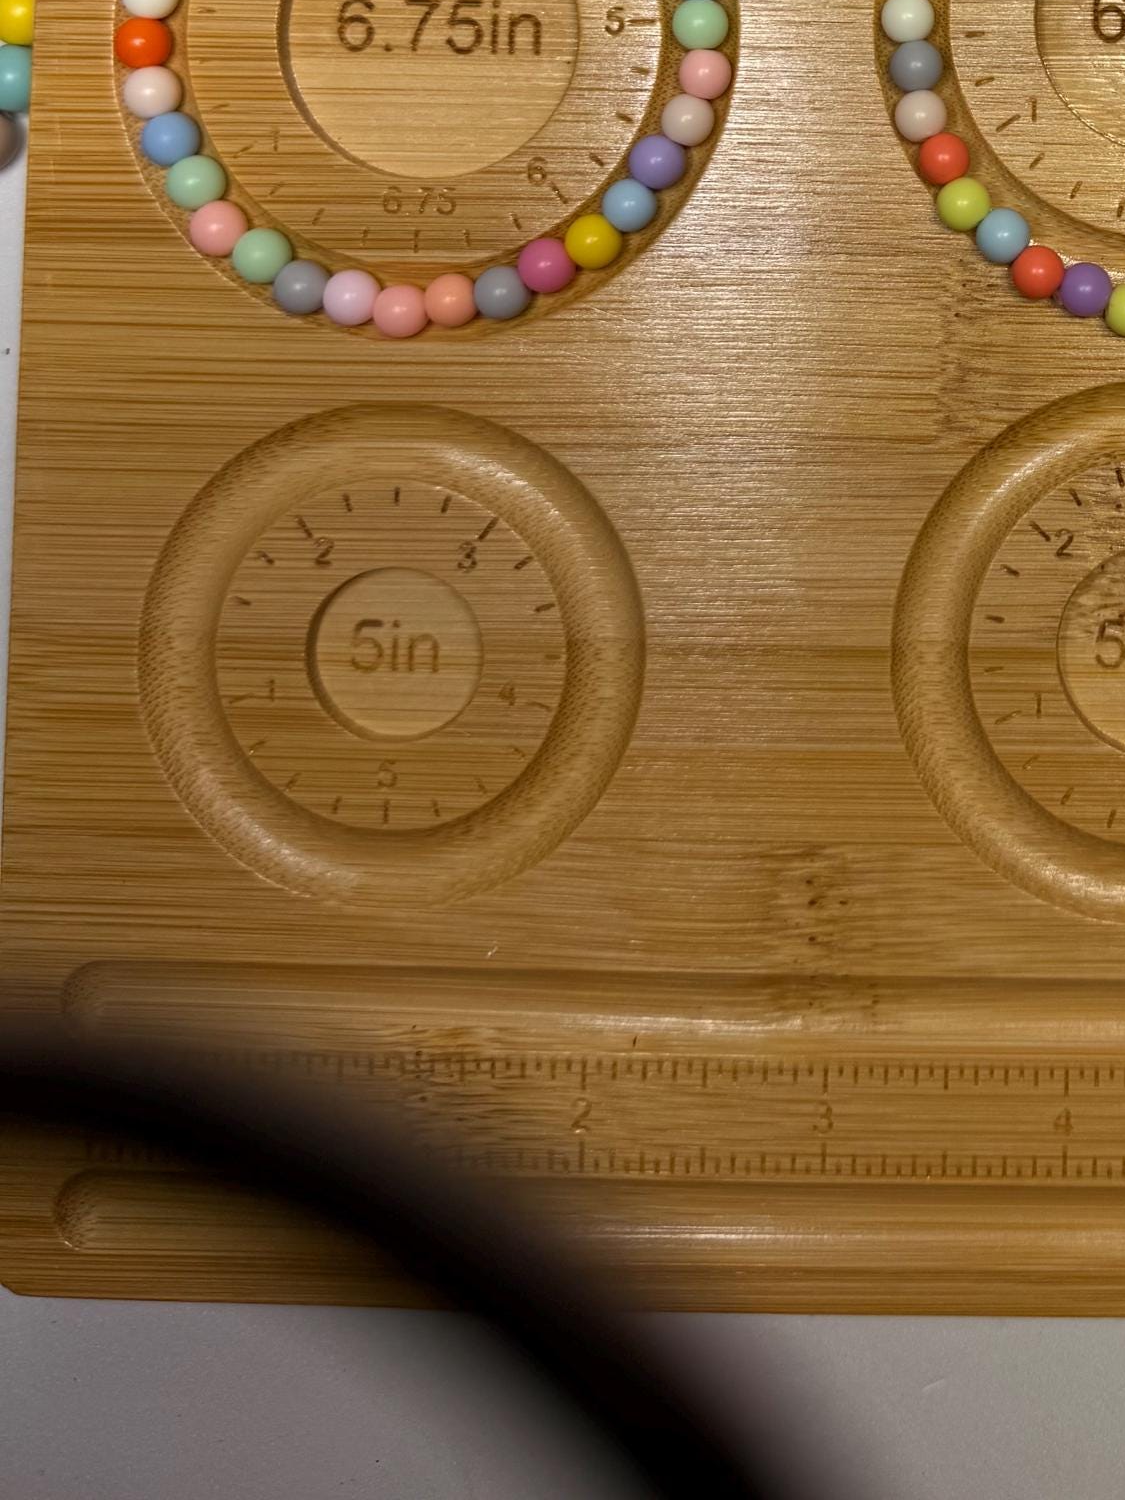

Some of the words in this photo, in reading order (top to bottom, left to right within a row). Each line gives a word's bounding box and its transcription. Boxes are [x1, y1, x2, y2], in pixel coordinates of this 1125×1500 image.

[606, 7, 625, 36] 5
[527, 156, 548, 187] 6
[315, 537, 334, 566] 2
[457, 540, 477, 573] 3
[1055, 528, 1073, 556] 2
[350, 618, 440, 674] 5in
[500, 682, 516, 706] 4
[377, 760, 397, 789] 5
[571, 1097, 592, 1134] 2
[813, 1102, 834, 1135] 3
[1053, 1107, 1074, 1136] 4
